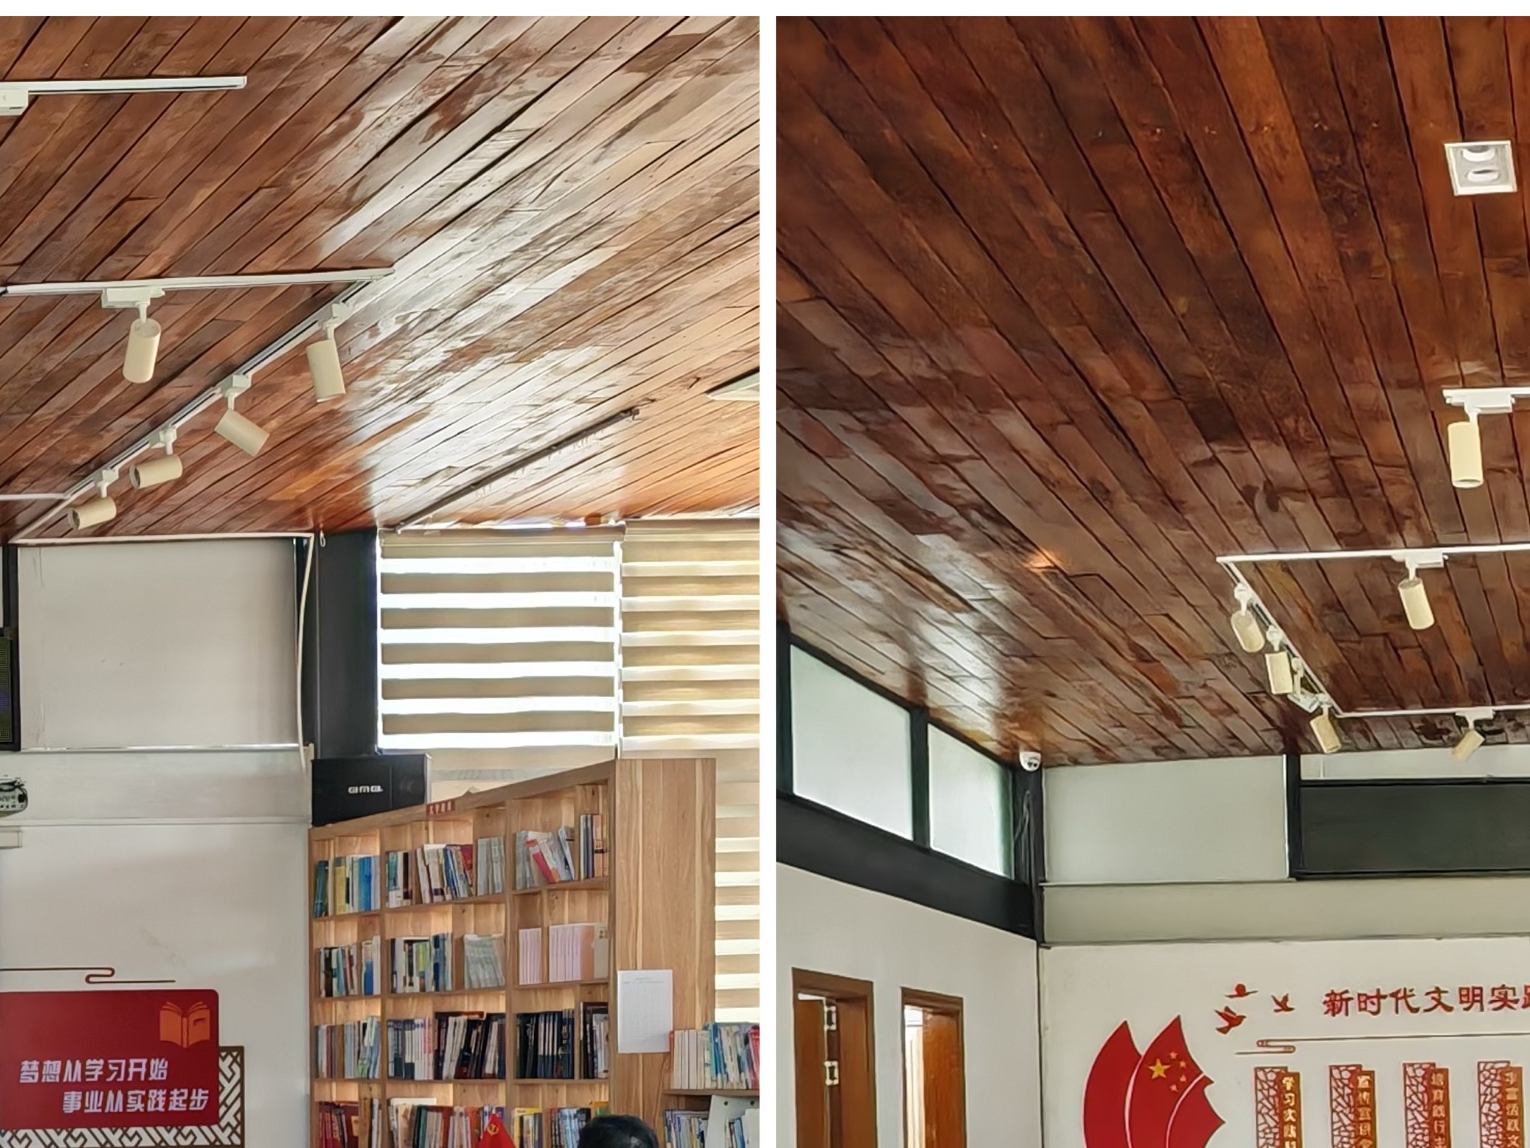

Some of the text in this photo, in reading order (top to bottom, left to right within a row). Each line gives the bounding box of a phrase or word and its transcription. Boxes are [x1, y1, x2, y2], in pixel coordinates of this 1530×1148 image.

[19, 1057, 169, 1084] 梦想从学习开始
[62, 1088, 210, 1114] 事业从实践起步
